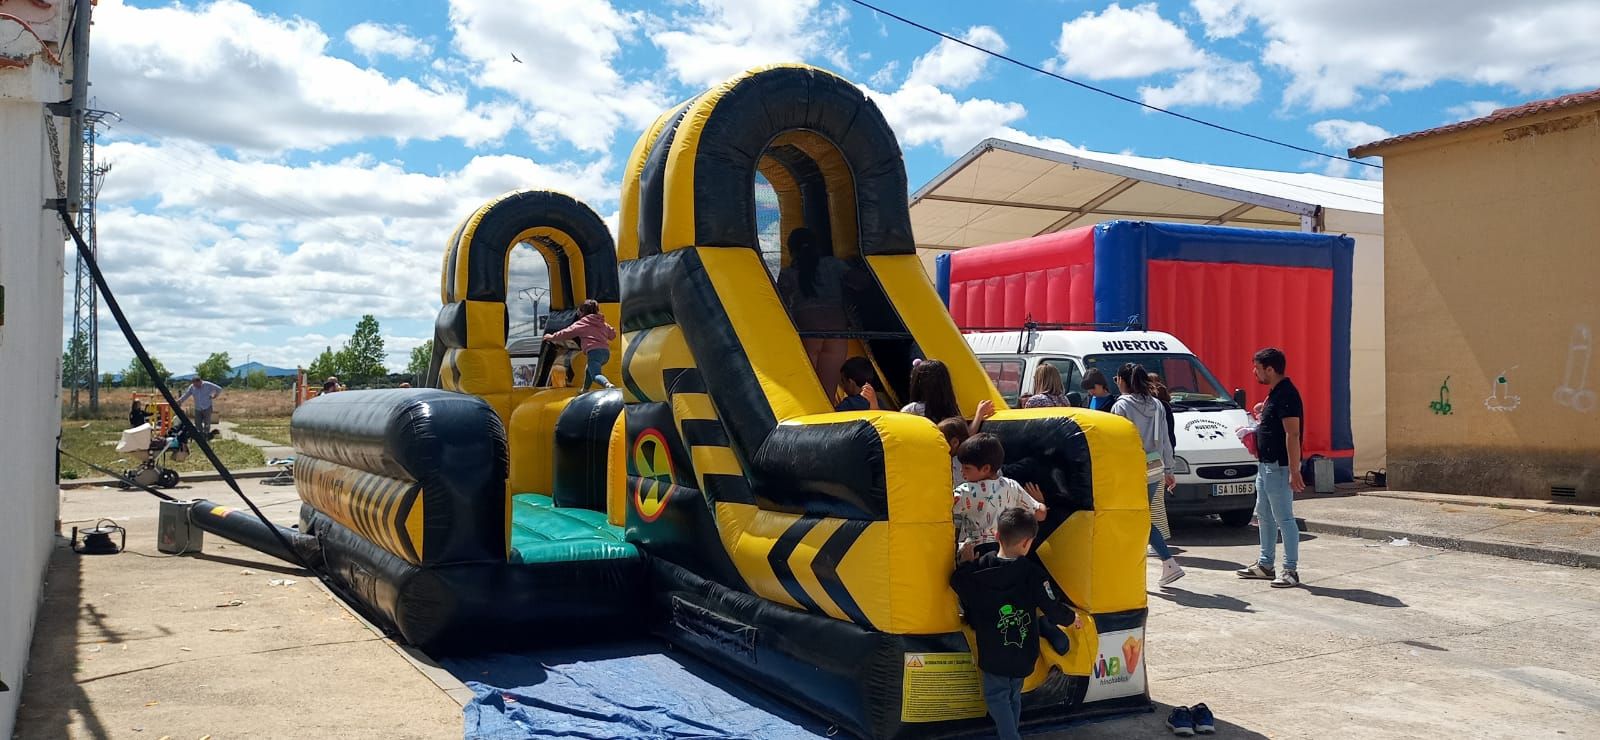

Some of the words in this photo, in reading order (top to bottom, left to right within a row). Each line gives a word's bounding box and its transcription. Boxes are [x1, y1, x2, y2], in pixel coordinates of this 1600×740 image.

[1102, 340, 1168, 351] HUERTOS
[1218, 485, 1228, 495] SA
[1230, 484, 1247, 494] 1166
